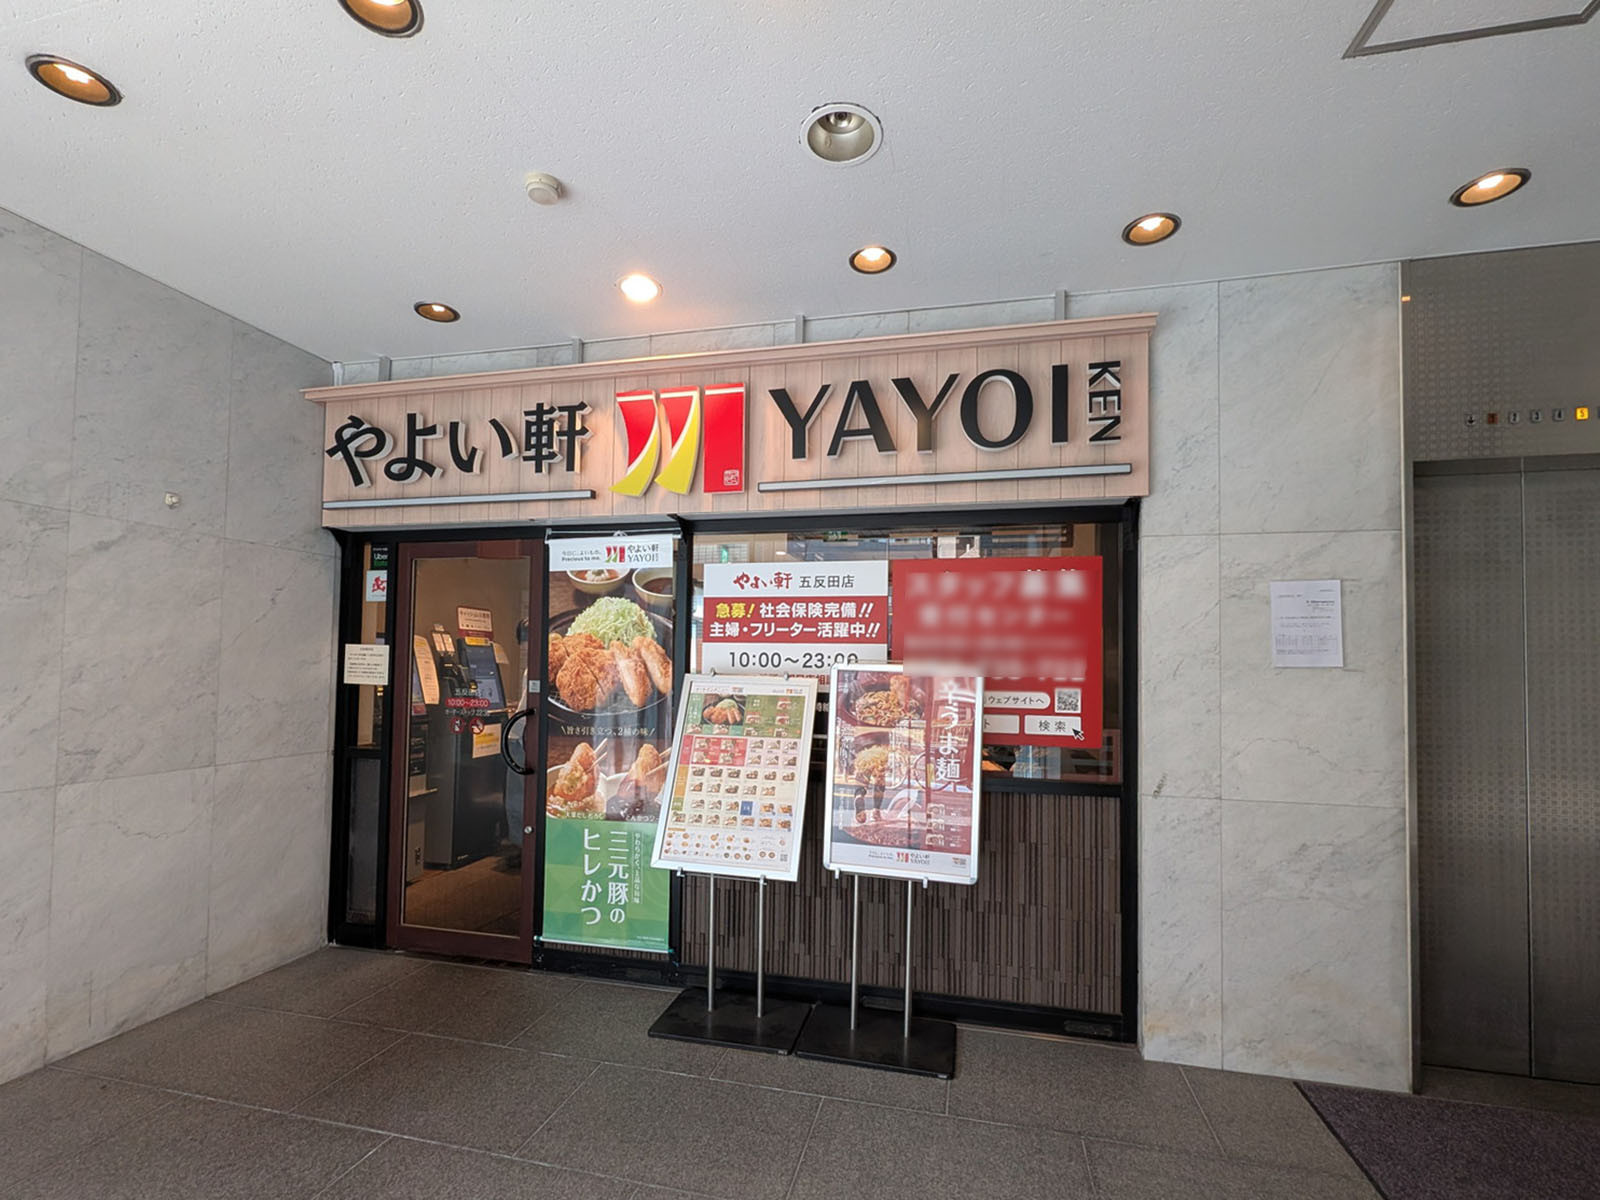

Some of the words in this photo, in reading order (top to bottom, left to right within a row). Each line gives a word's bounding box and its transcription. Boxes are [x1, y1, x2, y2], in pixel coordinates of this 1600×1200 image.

[1088, 359, 1121, 444] KEN
[768, 363, 1070, 460] YAYOI
[325, 401, 593, 488] やよい軒
[627, 543, 659, 554] やよい軒
[627, 553, 655, 563] YAYOI
[733, 571, 793, 590] やよい軒
[799, 574, 855, 589] 五反田店
[715, 602, 755, 619] 急募!
[759, 602, 874, 619] 社会保険完備!!
[709, 622, 881, 638] 主婦・フリーター活躍中!!
[1038, 720, 1066, 733] 検索
[581, 828, 602, 925] ヒレかつ
[607, 830, 629, 924] 三元豚の
